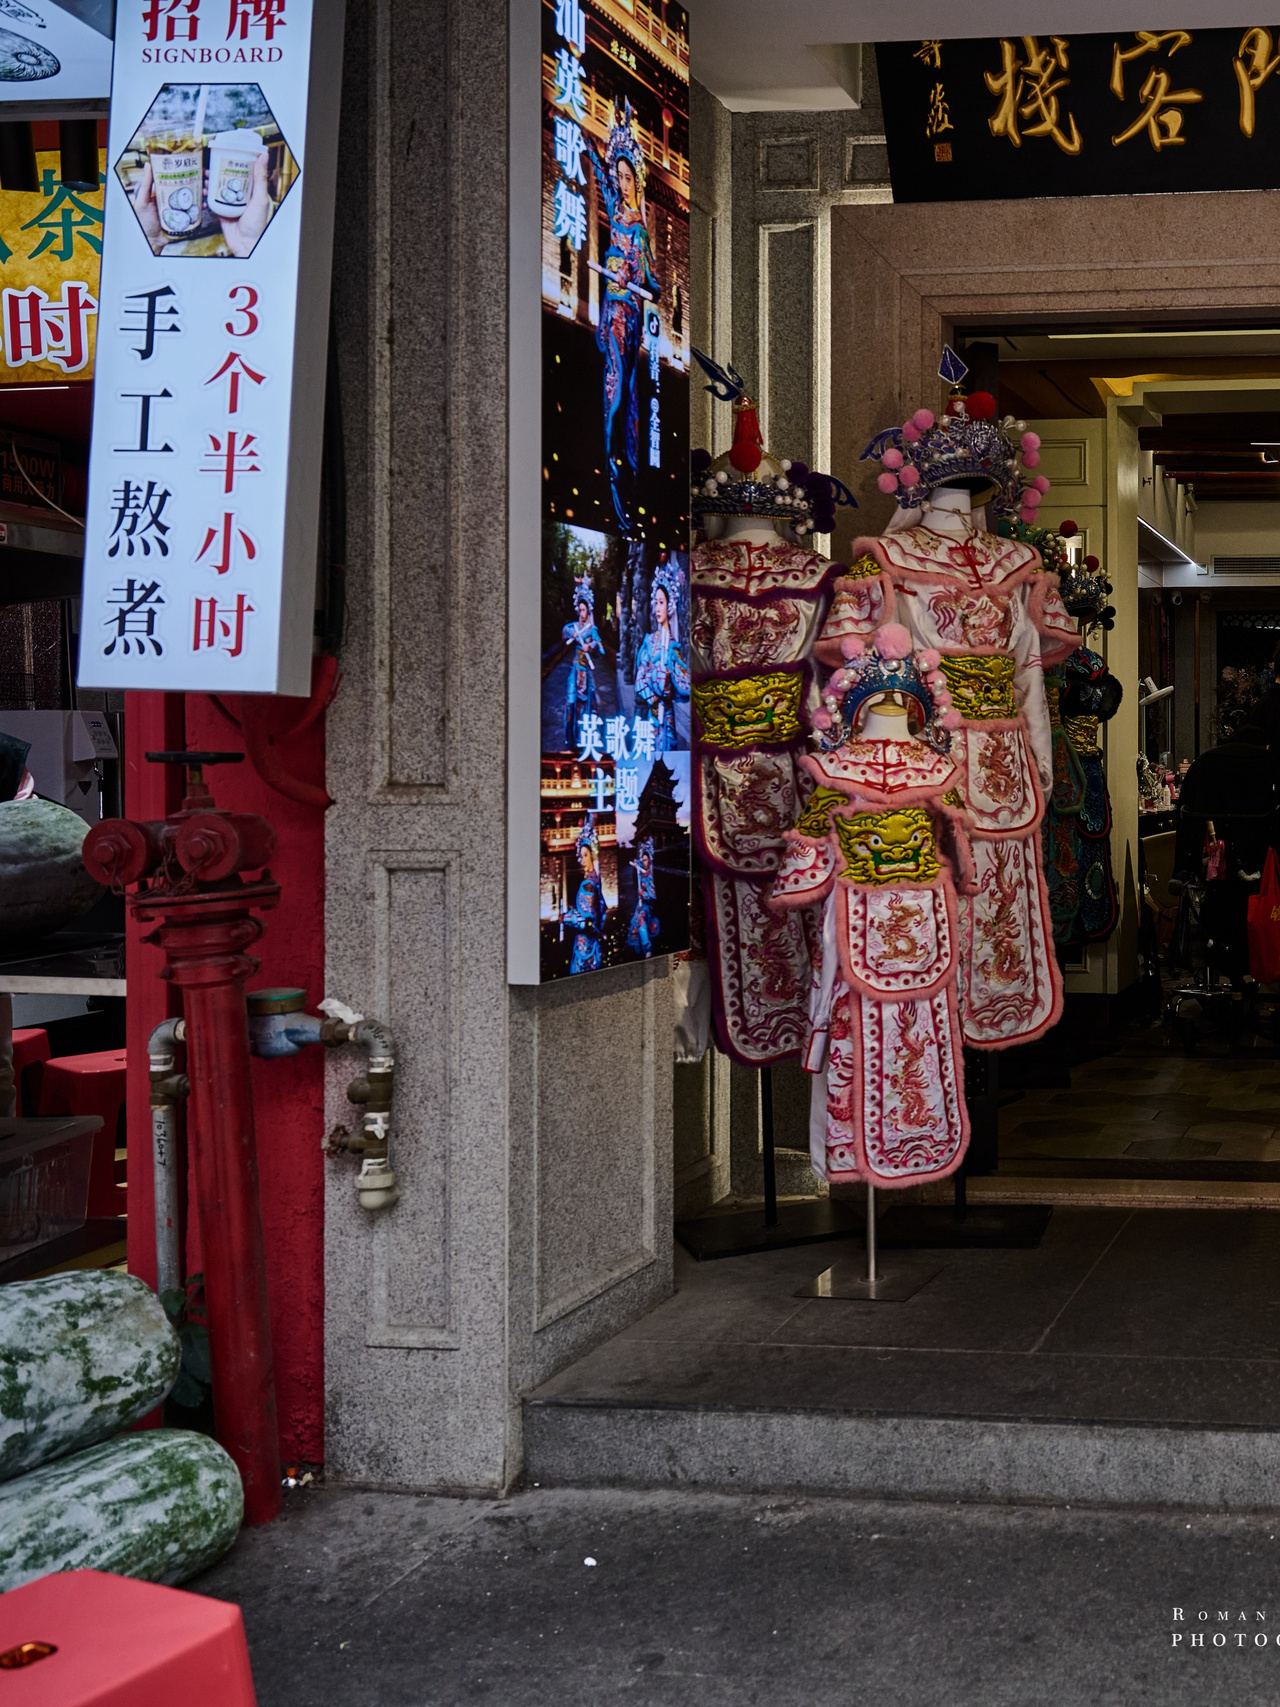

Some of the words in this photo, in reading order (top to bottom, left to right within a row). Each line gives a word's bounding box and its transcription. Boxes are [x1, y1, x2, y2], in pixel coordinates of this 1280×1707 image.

[142, 0, 287, 42] 招牌
[142, 47, 283, 63] SIGNBOARD
[0, 169, 107, 264] 茶
[8, 286, 96, 368] 时
[104, 285, 181, 656] 手工熬煮
[192, 285, 267, 658] 3个半小时
[577, 713, 656, 763] 英歌舞
[587, 767, 640, 813] 主题
